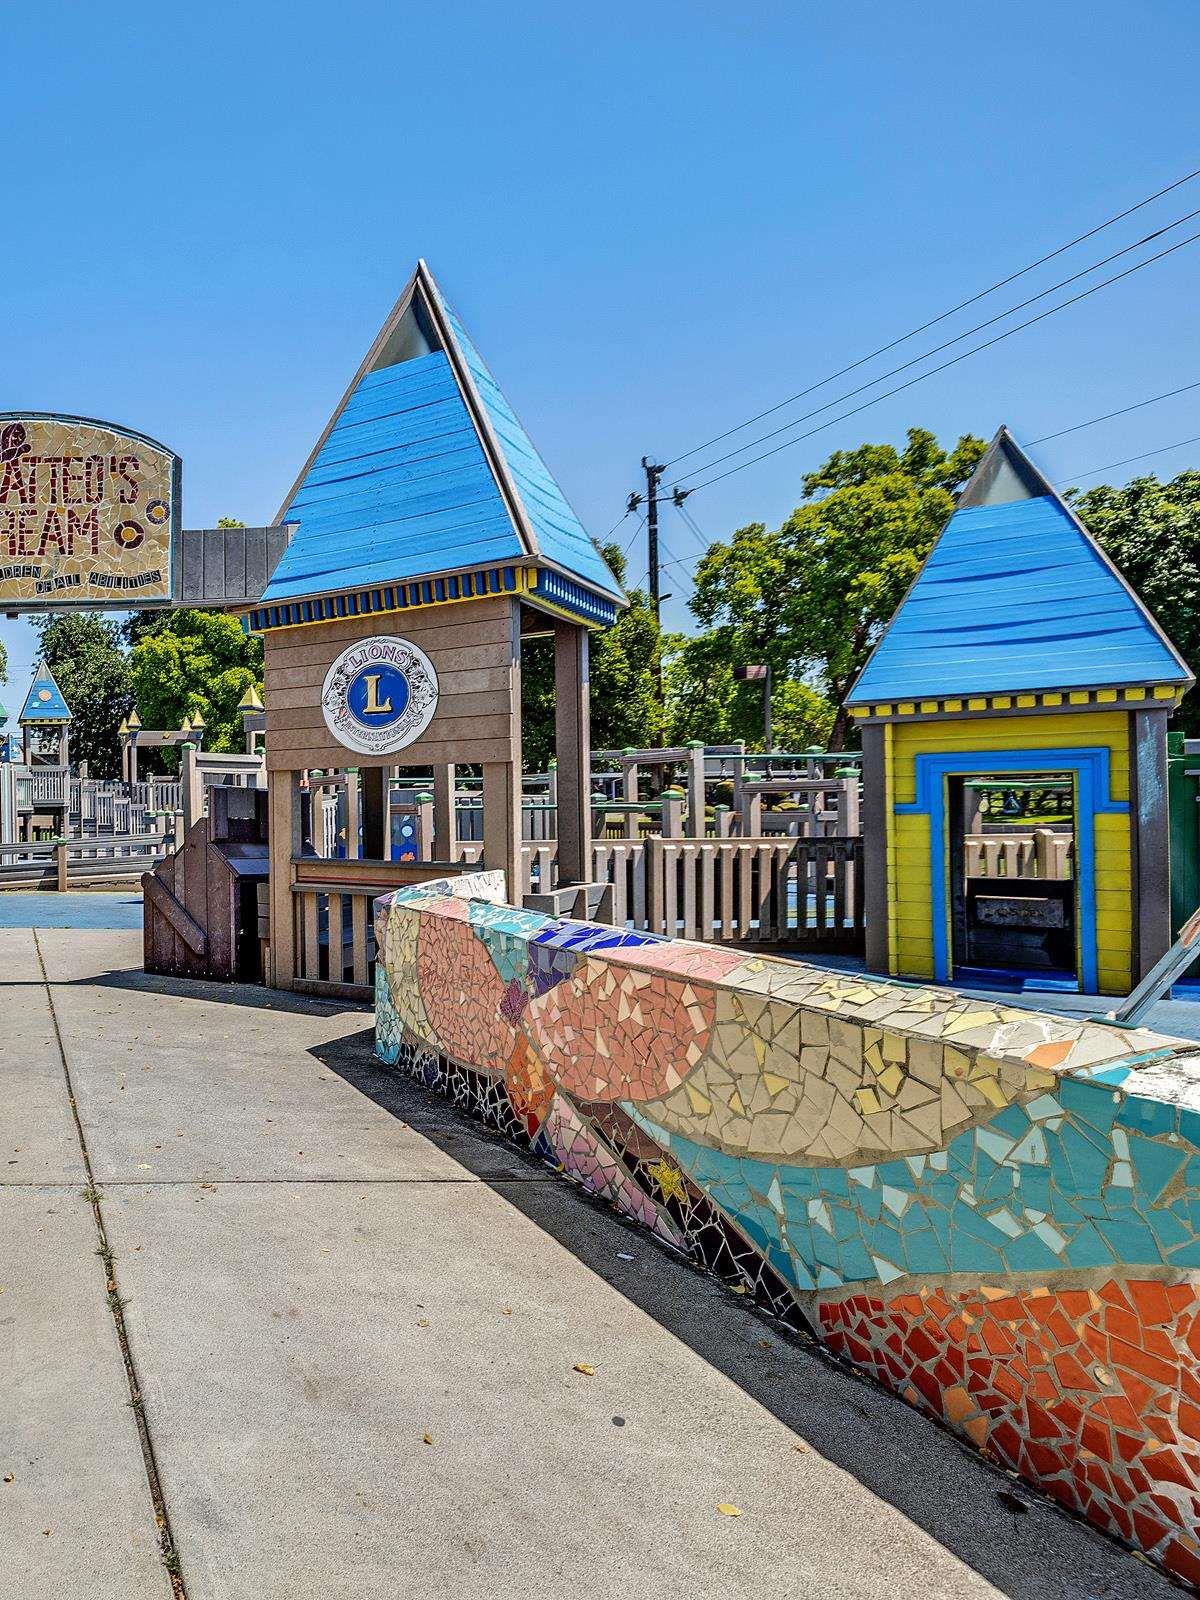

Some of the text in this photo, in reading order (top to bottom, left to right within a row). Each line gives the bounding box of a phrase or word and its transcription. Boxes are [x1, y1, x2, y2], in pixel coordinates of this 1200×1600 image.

[36, 580, 53, 594] OF
[54, 574, 81, 590] ALL
[89, 569, 162, 589] ABILITIES
[349, 644, 408, 668] LIONS
[362, 675, 393, 713] L
